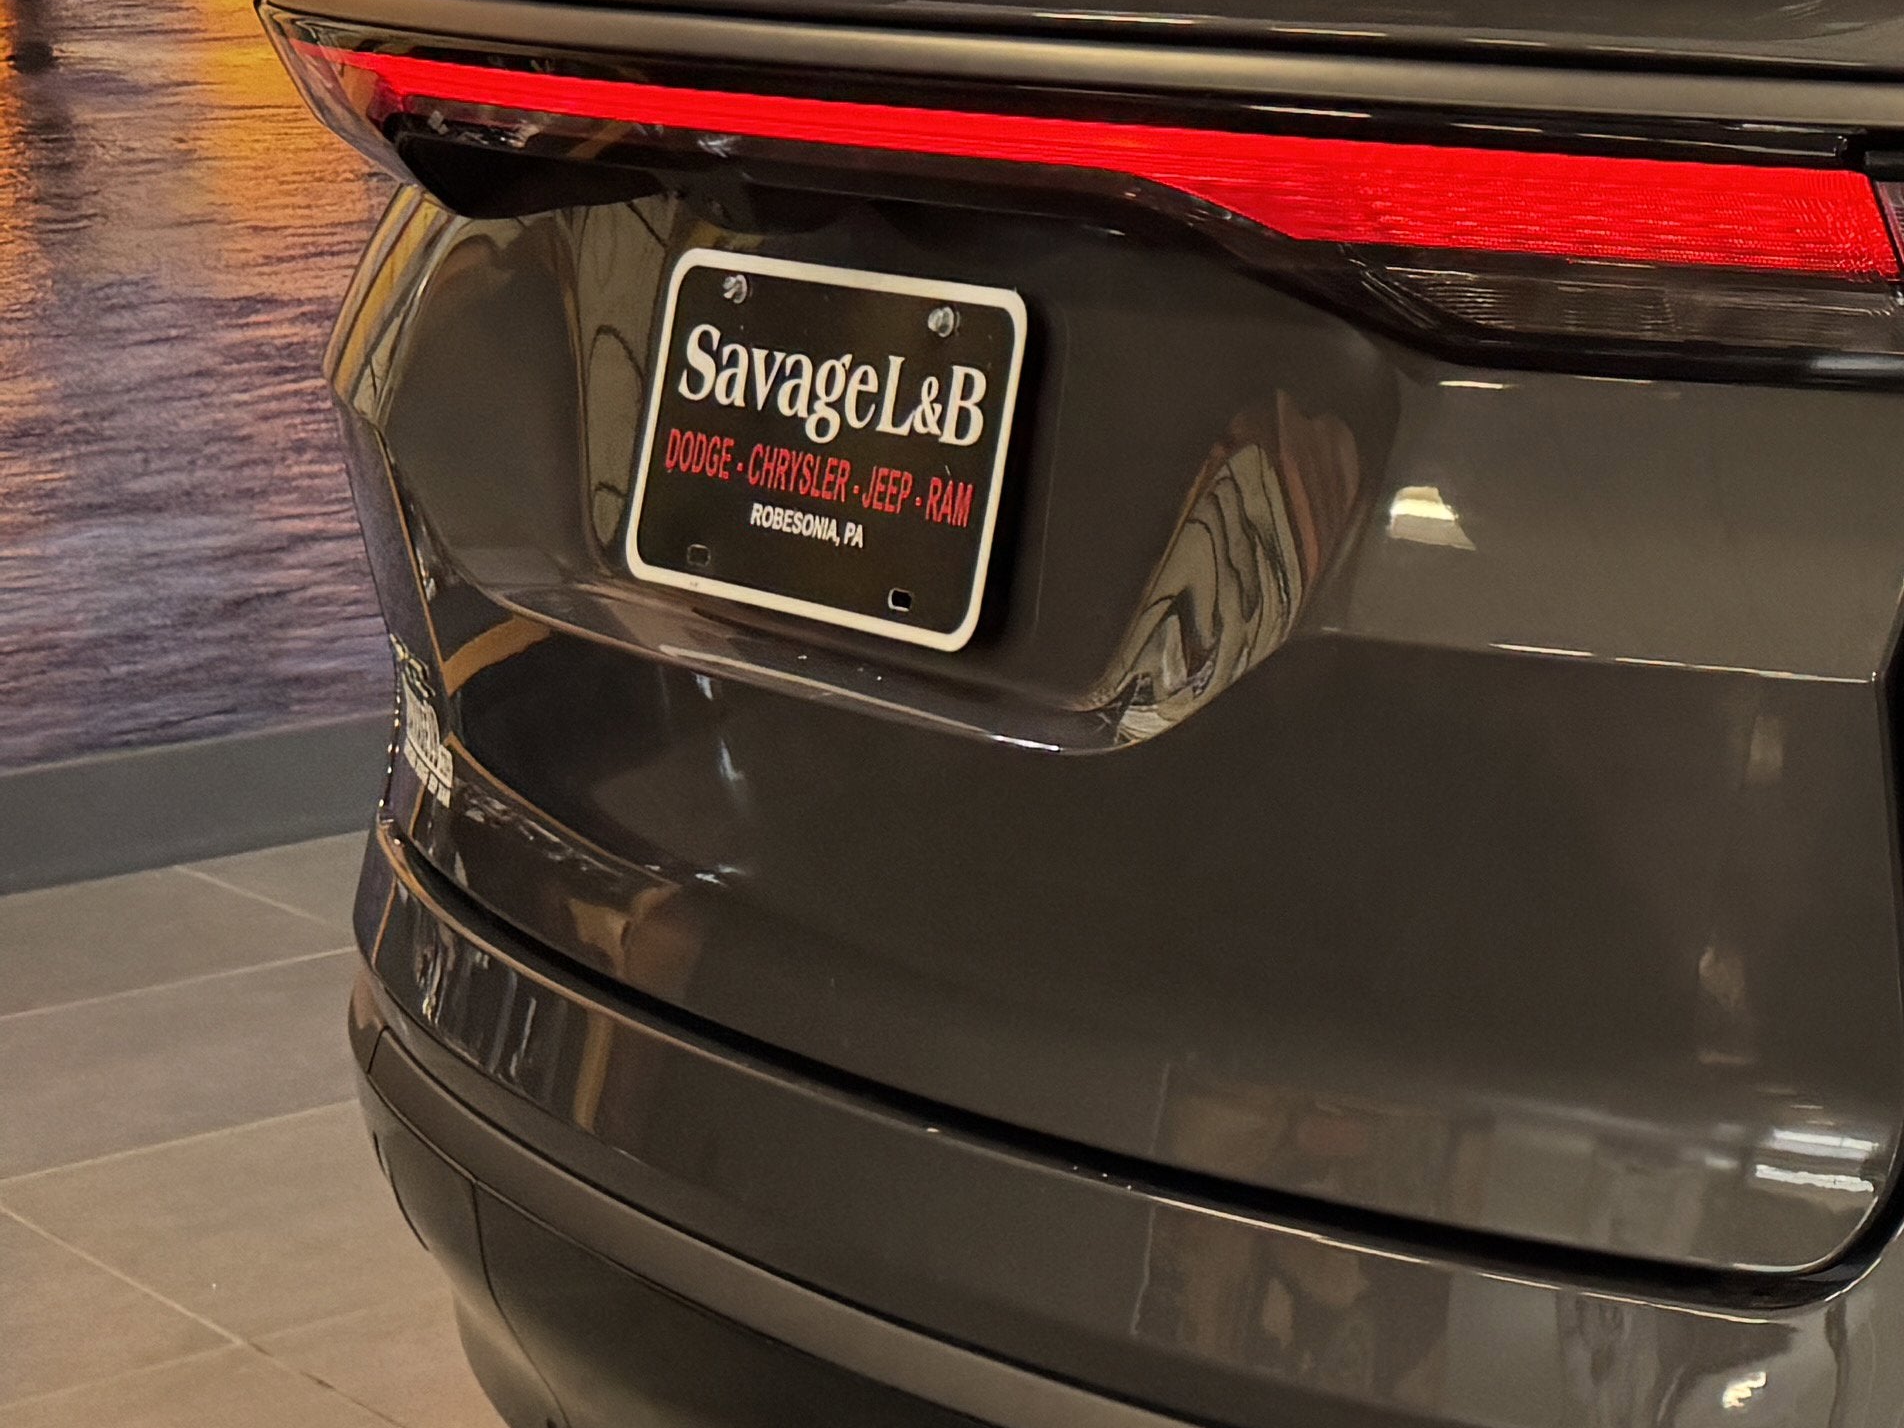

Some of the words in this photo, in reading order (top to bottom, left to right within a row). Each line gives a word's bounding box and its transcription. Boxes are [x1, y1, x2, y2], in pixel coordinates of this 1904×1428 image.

[664, 428, 735, 481] DODGE
[748, 442, 852, 503] CHRYSLER
[861, 465, 914, 514] JEEP
[925, 476, 974, 528] RAM
[750, 502, 841, 547] ROBESONIA,
[843, 521, 865, 549] PA
